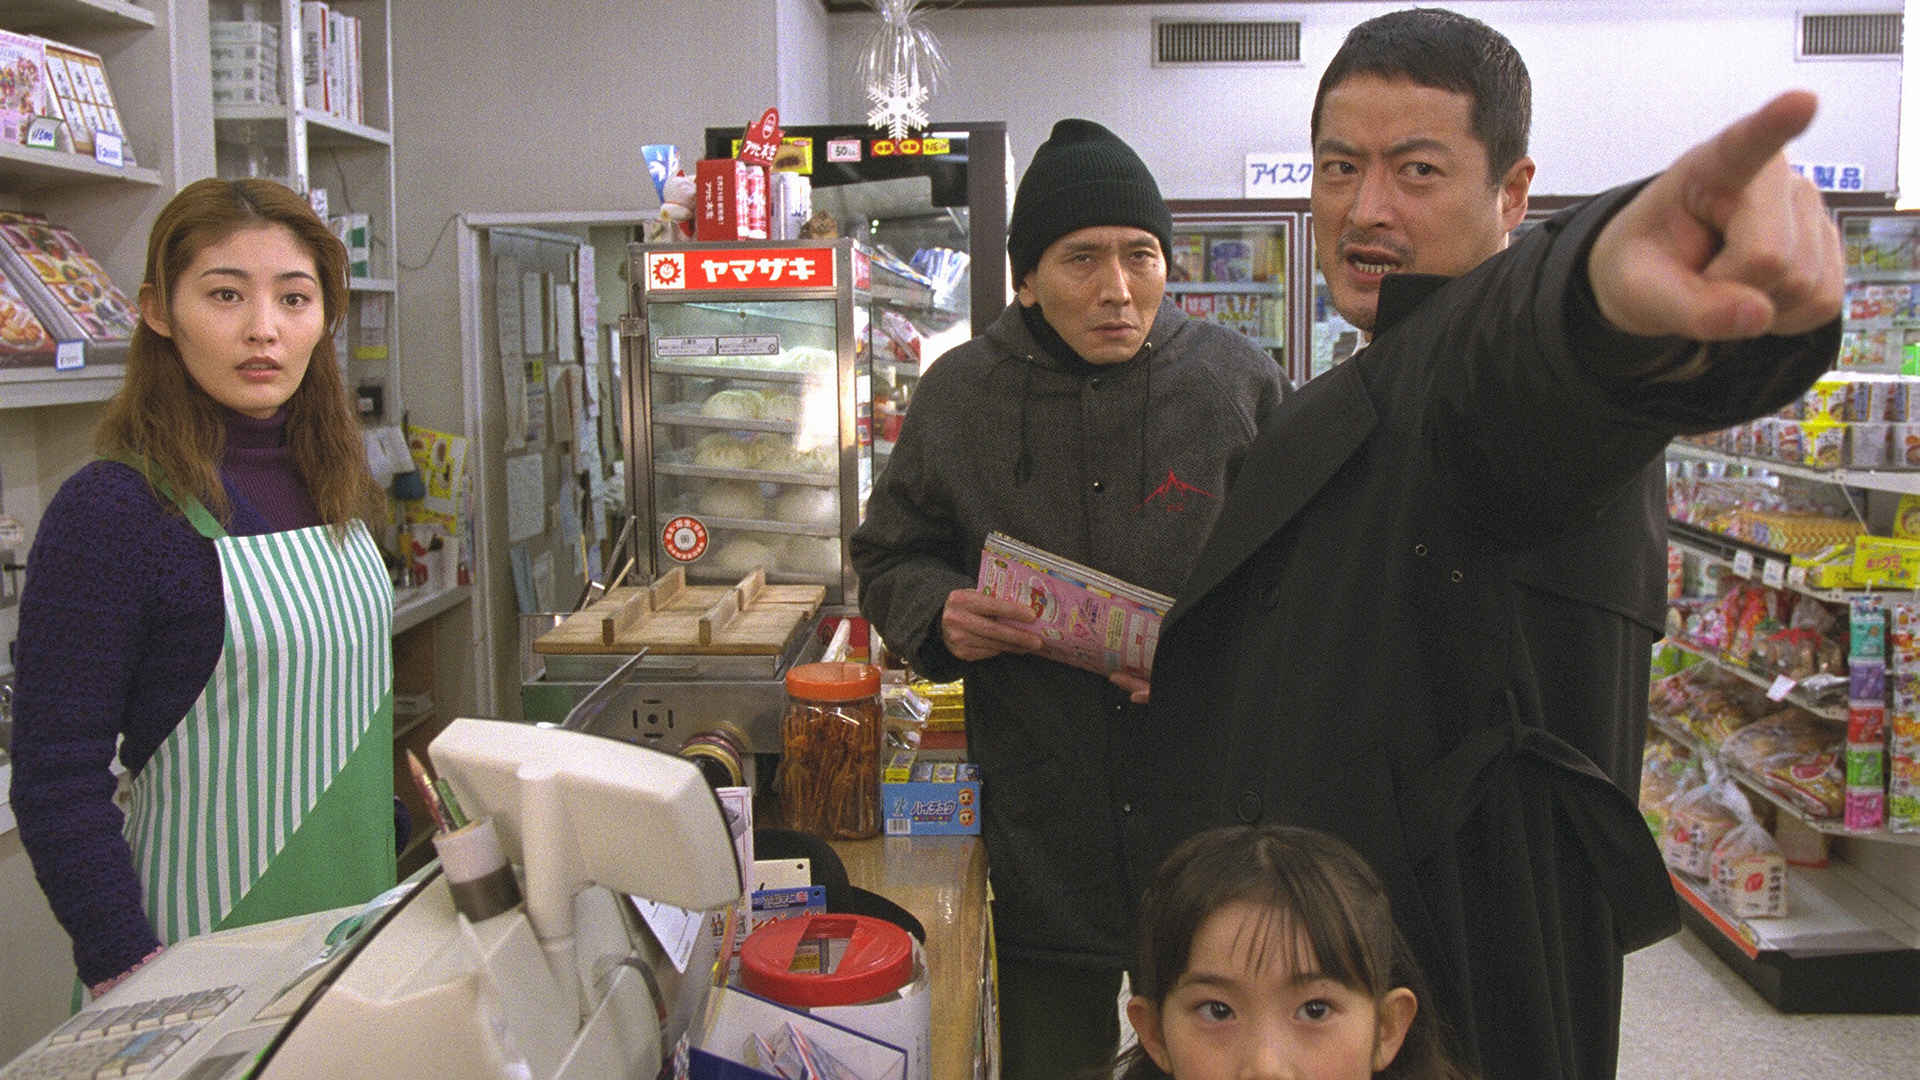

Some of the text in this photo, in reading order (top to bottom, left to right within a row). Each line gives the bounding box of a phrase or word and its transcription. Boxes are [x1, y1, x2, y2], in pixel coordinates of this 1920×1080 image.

[743, 140, 778, 161] アサヒ本生
[1792, 164, 1861, 189] 製品
[701, 257, 816, 283] ヤマザキ
[910, 799, 957, 816] ハイチュウ
